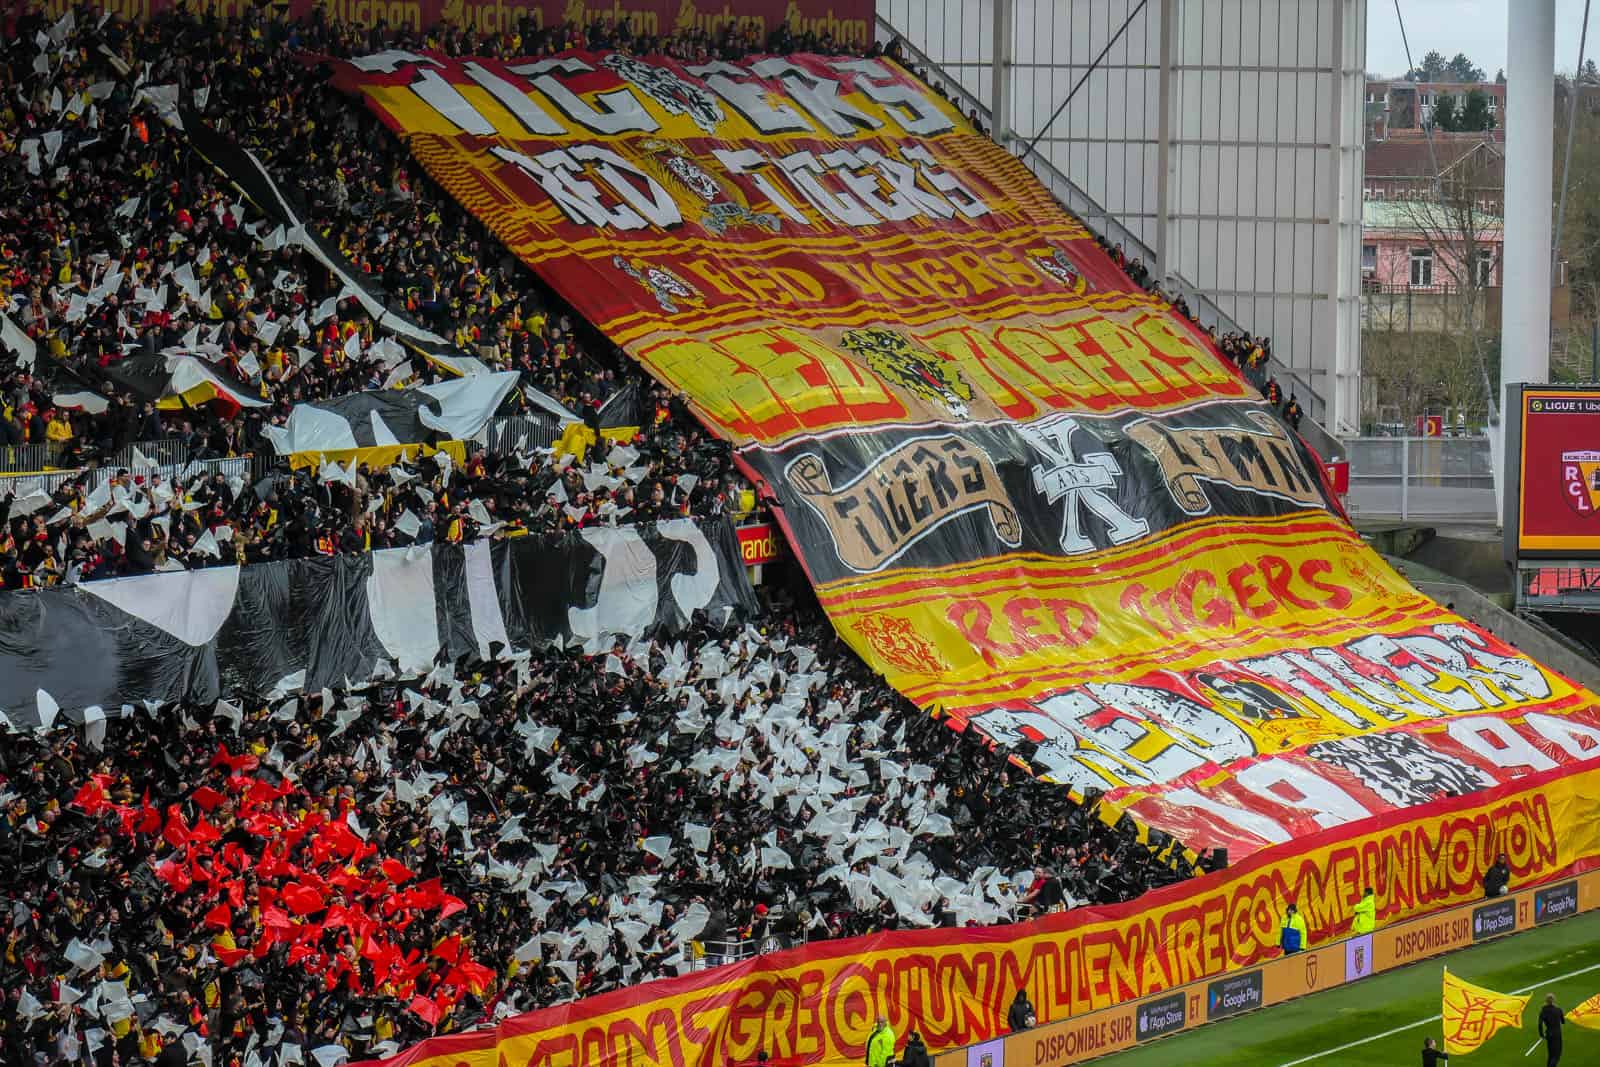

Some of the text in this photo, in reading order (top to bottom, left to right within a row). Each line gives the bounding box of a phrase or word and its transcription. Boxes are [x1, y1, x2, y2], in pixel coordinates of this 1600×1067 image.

[487, 144, 993, 230] RED TIGERS
[679, 260, 826, 304] RED
[637, 326, 909, 439] RED
[1545, 402, 1576, 410] LIGUE
[1577, 402, 1583, 410] 1
[833, 440, 986, 556] TIGERS
[1056, 469, 1091, 489] ANS
[945, 554, 1352, 669] RED TIGERS
[1519, 901, 1529, 924] ET
[1394, 918, 1470, 959] DISPONIBLE SUR
[1166, 1011, 1182, 1025] Store
[1189, 995, 1201, 1021] ET
[1224, 990, 1246, 1008] Google
[1035, 1015, 1133, 1066] DISPONIBLE SUR
